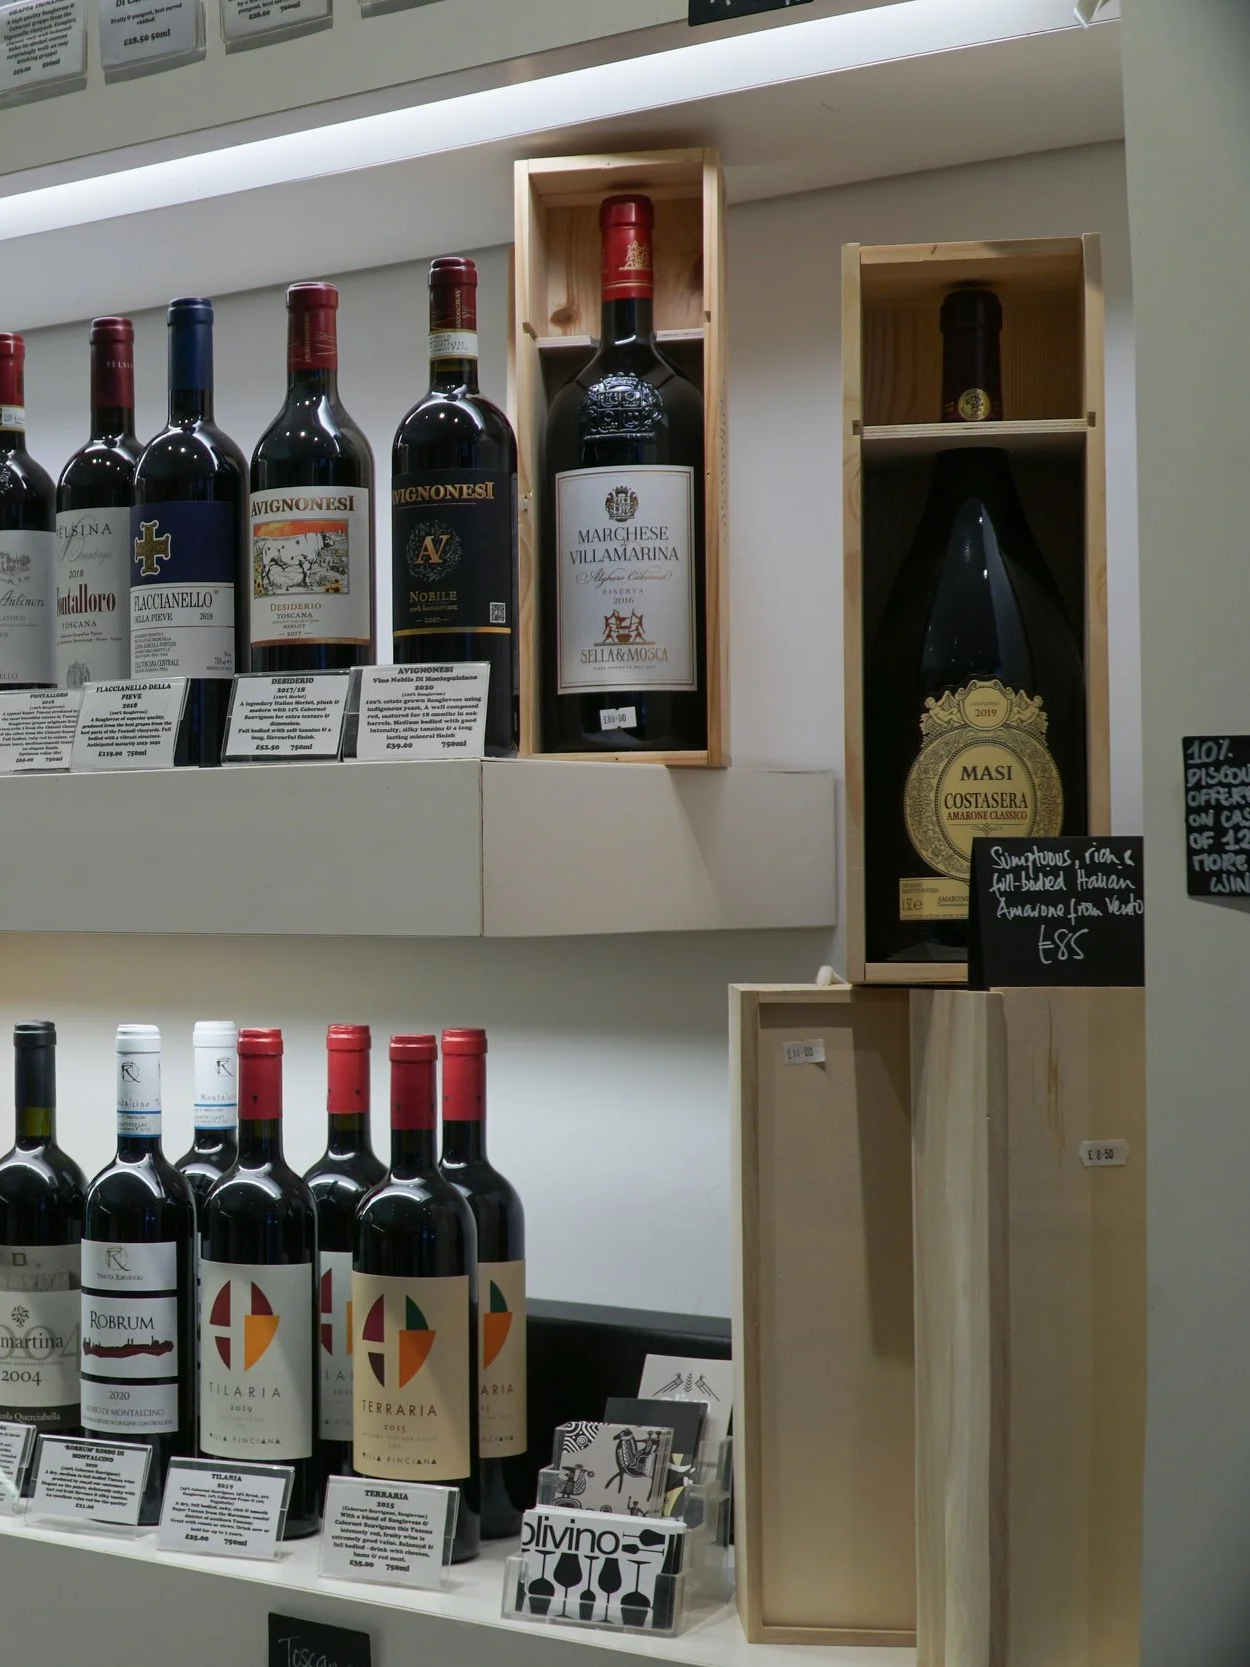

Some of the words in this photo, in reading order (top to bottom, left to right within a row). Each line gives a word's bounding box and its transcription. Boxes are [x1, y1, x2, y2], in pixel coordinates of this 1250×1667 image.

[150, 28, 171, 41] 50ml
[251, 494, 356, 517] AVIGNONESI
[578, 525, 669, 544] MARCHESE
[415, 534, 450, 565] AV
[569, 546, 680, 565] VILLAMARINA
[68, 569, 84, 579] 2018
[602, 587, 645, 595] RISERVA
[134, 591, 213, 612] FLACCIANELLO
[409, 591, 457, 602] NOBILE
[613, 596, 635, 605] 2016
[269, 602, 322, 612] DESIDERIO
[151, 612, 173, 621] PIEVE
[200, 612, 213, 620] 2018
[62, 621, 97, 630] TOSCANA
[397, 666, 454, 675] AVIGNONESI
[271, 677, 314, 685] DESIDERIO
[425, 675, 478, 683] Montepulciano
[96, 684, 147, 693] FLACCIANELLO
[446, 703, 479, 711] composed
[974, 709, 997, 718] 2019
[441, 740, 467, 748] 750ml
[126, 749, 147, 757] 750ml
[960, 765, 1013, 781] MASI
[944, 792, 1028, 809] COSTASERA
[946, 811, 989, 821] AMARONE
[989, 811, 1028, 821] CLASSICO
[1188, 809, 1215, 828] ON
[1189, 831, 1215, 850] OF
[996, 896, 1065, 920] Amarone
[1067, 898, 1103, 926] from
[1038, 924, 1090, 965] £85
[90, 1310, 155, 1330] ROBRUM
[1, 1370, 43, 1386] 2004
[108, 1390, 130, 1400] 2020
[209, 1382, 281, 1399] TILARIA
[110, 1408, 165, 1417] MONTALCINO
[230, 1404, 253, 1414] 2019
[361, 1400, 438, 1417] TERRARIA
[14, 1410, 61, 1423] Querciabella
[384, 1424, 407, 1433] 2015
[232, 1436, 282, 1446] PINCIANA
[72, 1453, 114, 1463] MONTALCINO
[386, 1456, 438, 1466] PINCIANA
[211, 1473, 242, 1482] TILARIA
[364, 1489, 409, 1501] TERRARIA
[376, 1501, 395, 1509] 2015
[223, 1538, 248, 1547] 750ml
[349, 1560, 374, 1568] £35.00
[385, 1563, 410, 1572] 750ml
